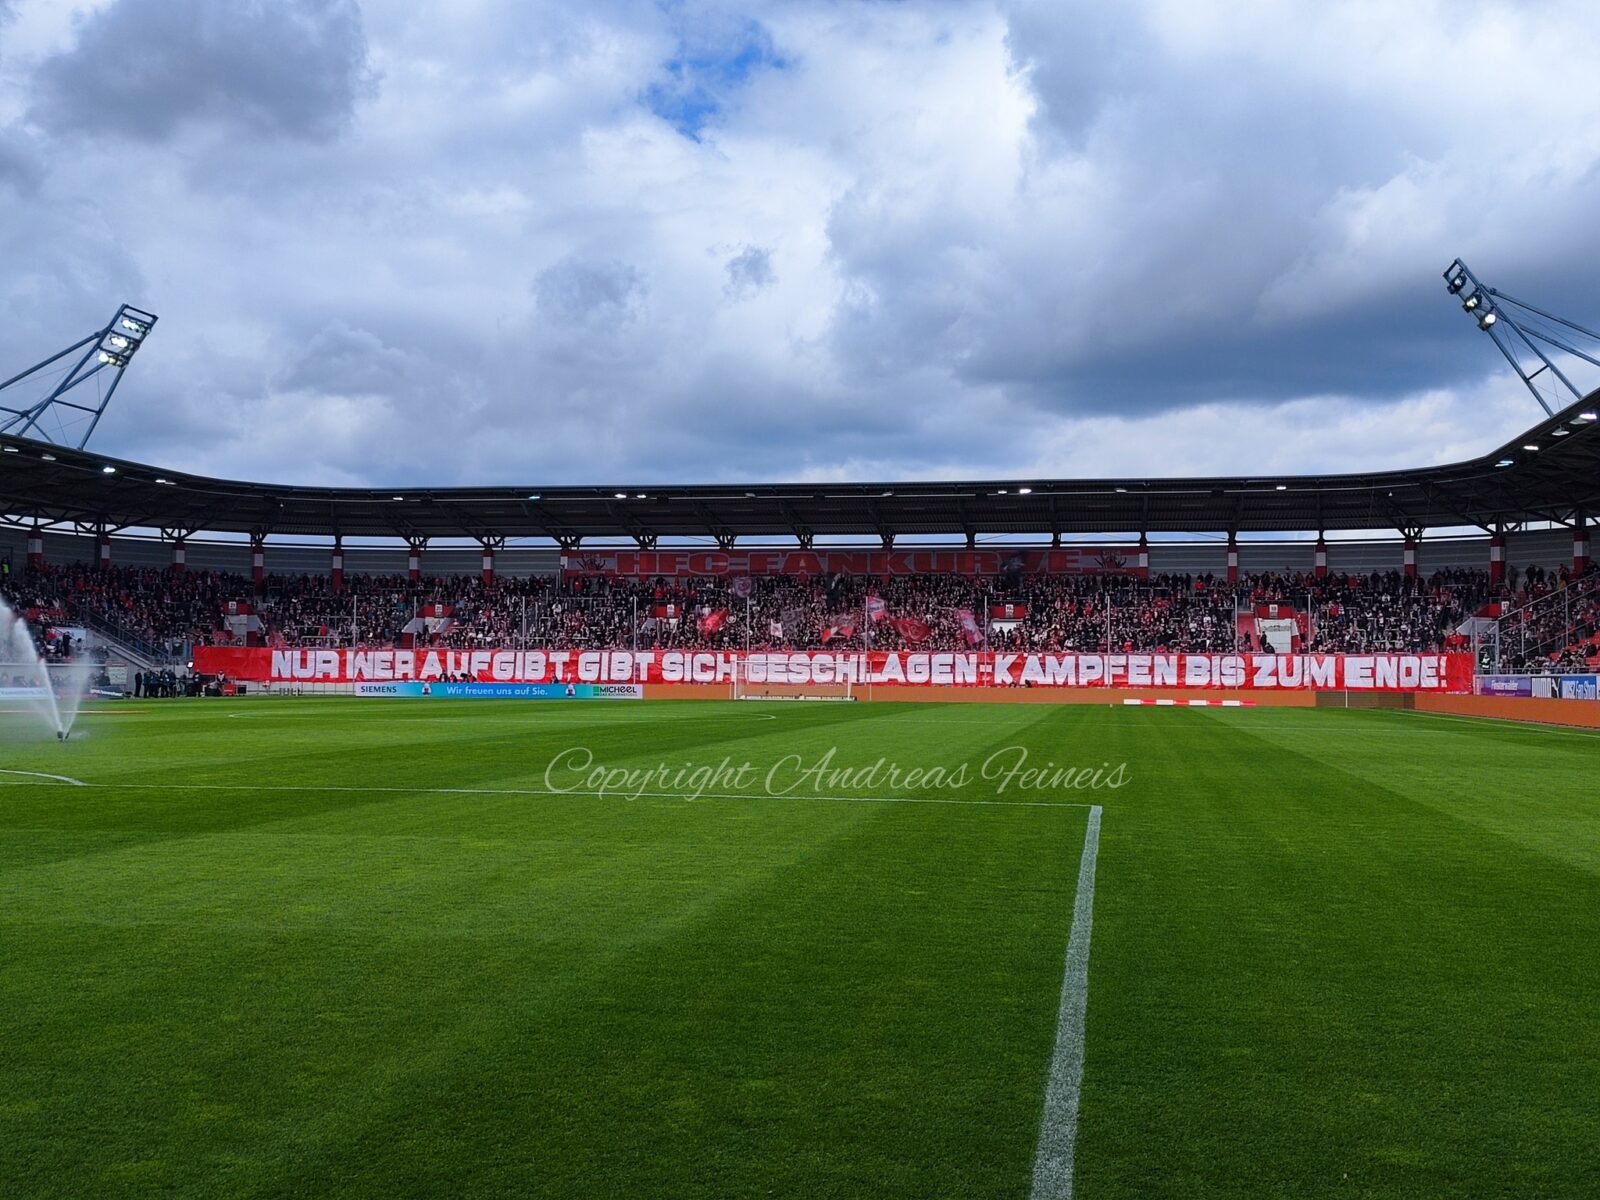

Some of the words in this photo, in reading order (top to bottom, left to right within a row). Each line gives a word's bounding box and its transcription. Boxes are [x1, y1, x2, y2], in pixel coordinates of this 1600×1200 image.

[271, 650, 339, 678] NUR
[346, 651, 415, 679] WER
[419, 651, 572, 681] AUFGIBT,
[578, 652, 654, 681] GIBT
[661, 652, 737, 682] SICH
[994, 653, 1177, 686] KÄMPFEN
[1185, 655, 1246, 687] BIS
[1252, 656, 1336, 688] ZUM
[1344, 656, 1447, 689] ENDE!
[446, 686, 462, 695] Wir
[465, 686, 493, 695] freuen
[514, 687, 529, 696] auf
[532, 687, 548, 696] Sie.
